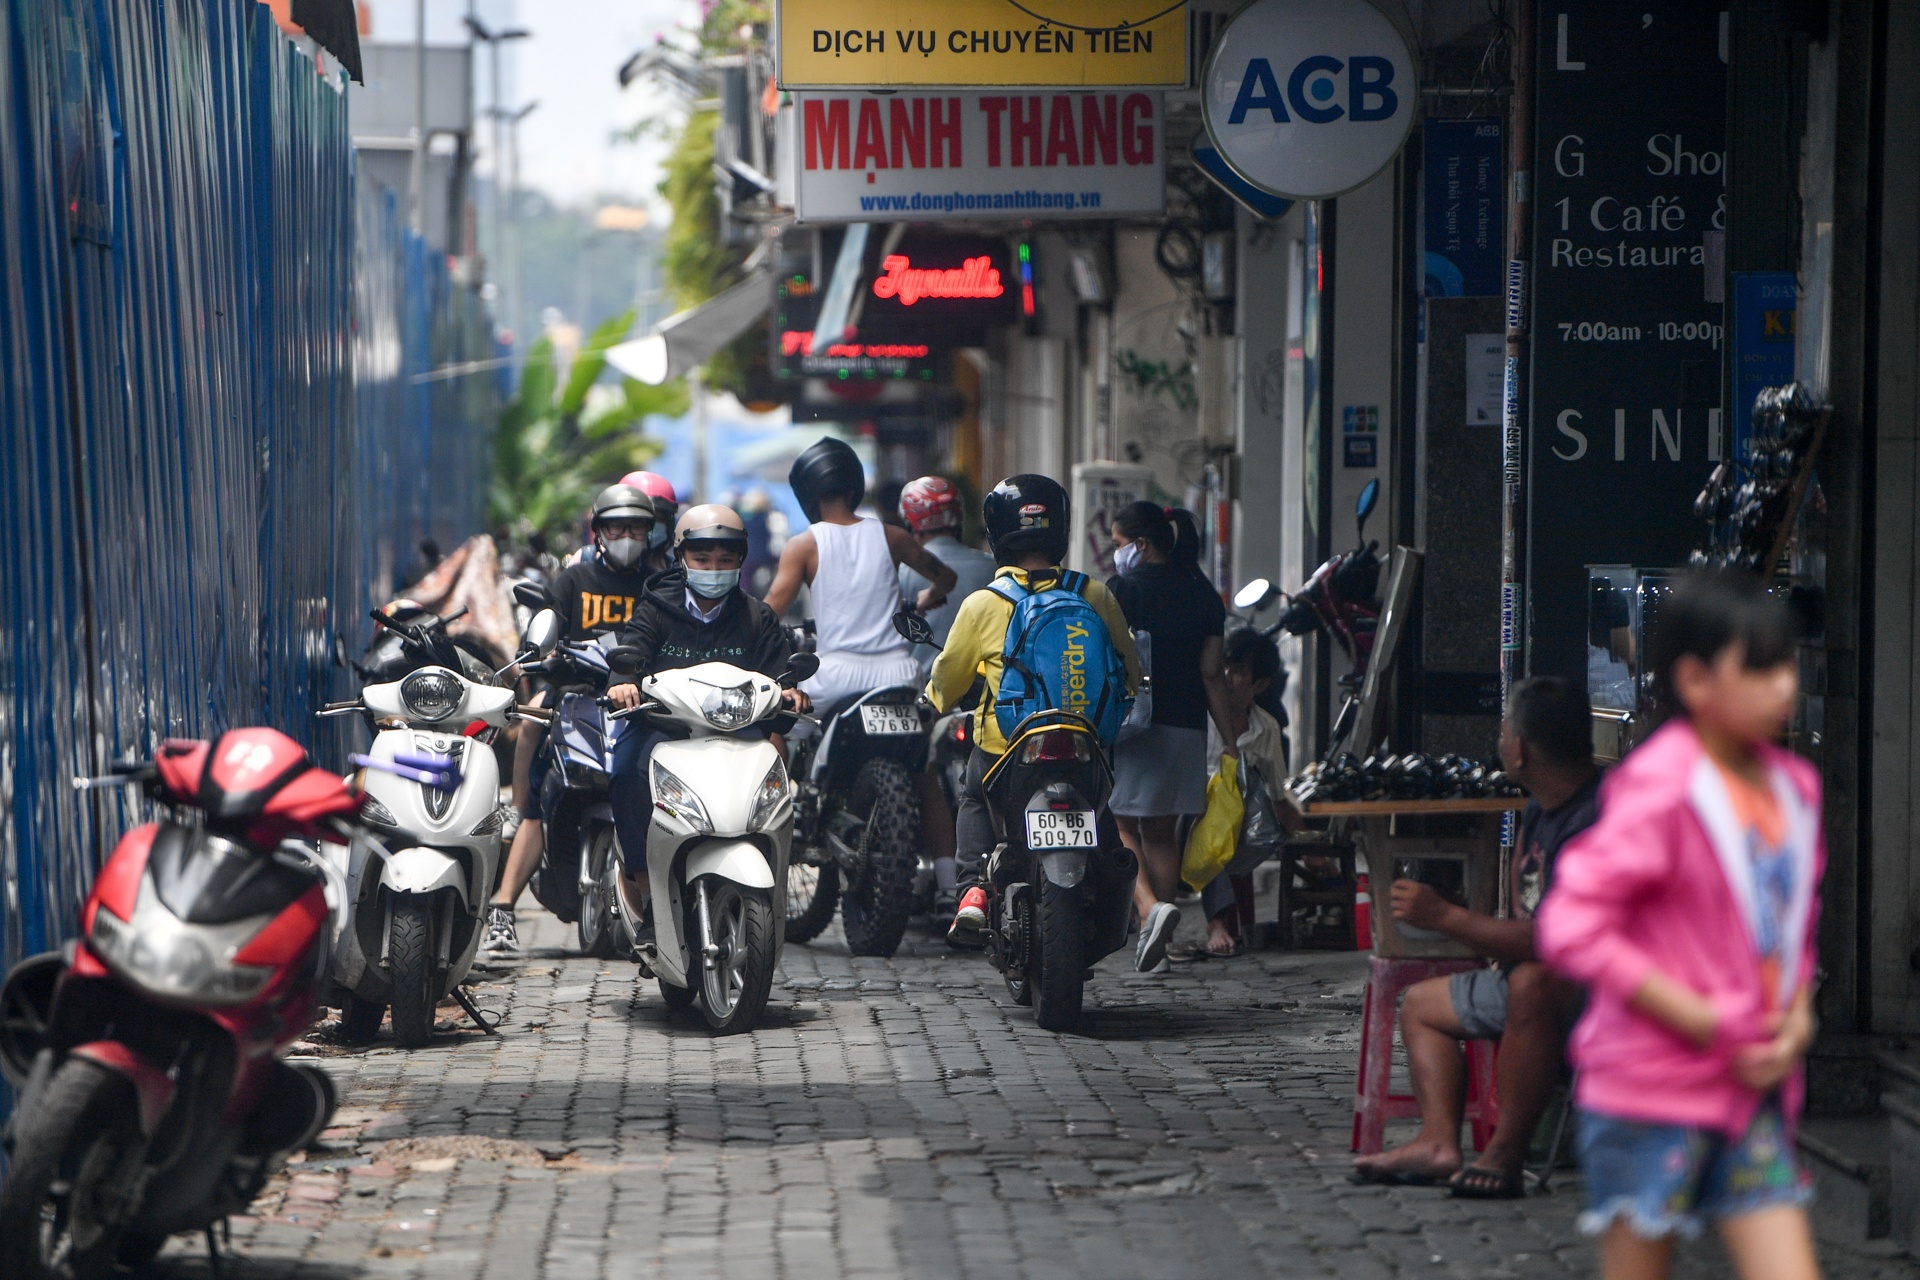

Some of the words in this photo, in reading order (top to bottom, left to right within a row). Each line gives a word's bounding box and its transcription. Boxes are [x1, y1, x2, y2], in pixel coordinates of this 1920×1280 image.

[813, 30, 885, 57] DỊCH
[897, 30, 936, 57] VỤ
[948, 18, 1074, 53] CHUYỂN
[1085, 20, 1153, 53] TIỀN
[1228, 55, 1398, 125] ACB
[803, 97, 962, 184] MẠNH
[1475, 125, 1500, 137] ACB
[1475, 155, 1490, 191] Money
[1554, 134, 1586, 178] G
[1646, 133, 1727, 188] Sho
[860, 189, 1102, 212] www.donghomanhthang.vn
[1554, 197, 1570, 231] 1
[1590, 195, 1686, 232] Café
[1475, 198, 1491, 250] Exchange
[1558, 321, 1641, 342] 7:00am
[868, 718, 918, 732] 576.87
[1033, 830, 1093, 847] 509.70
[1038, 813, 1085, 829] 60-B6
